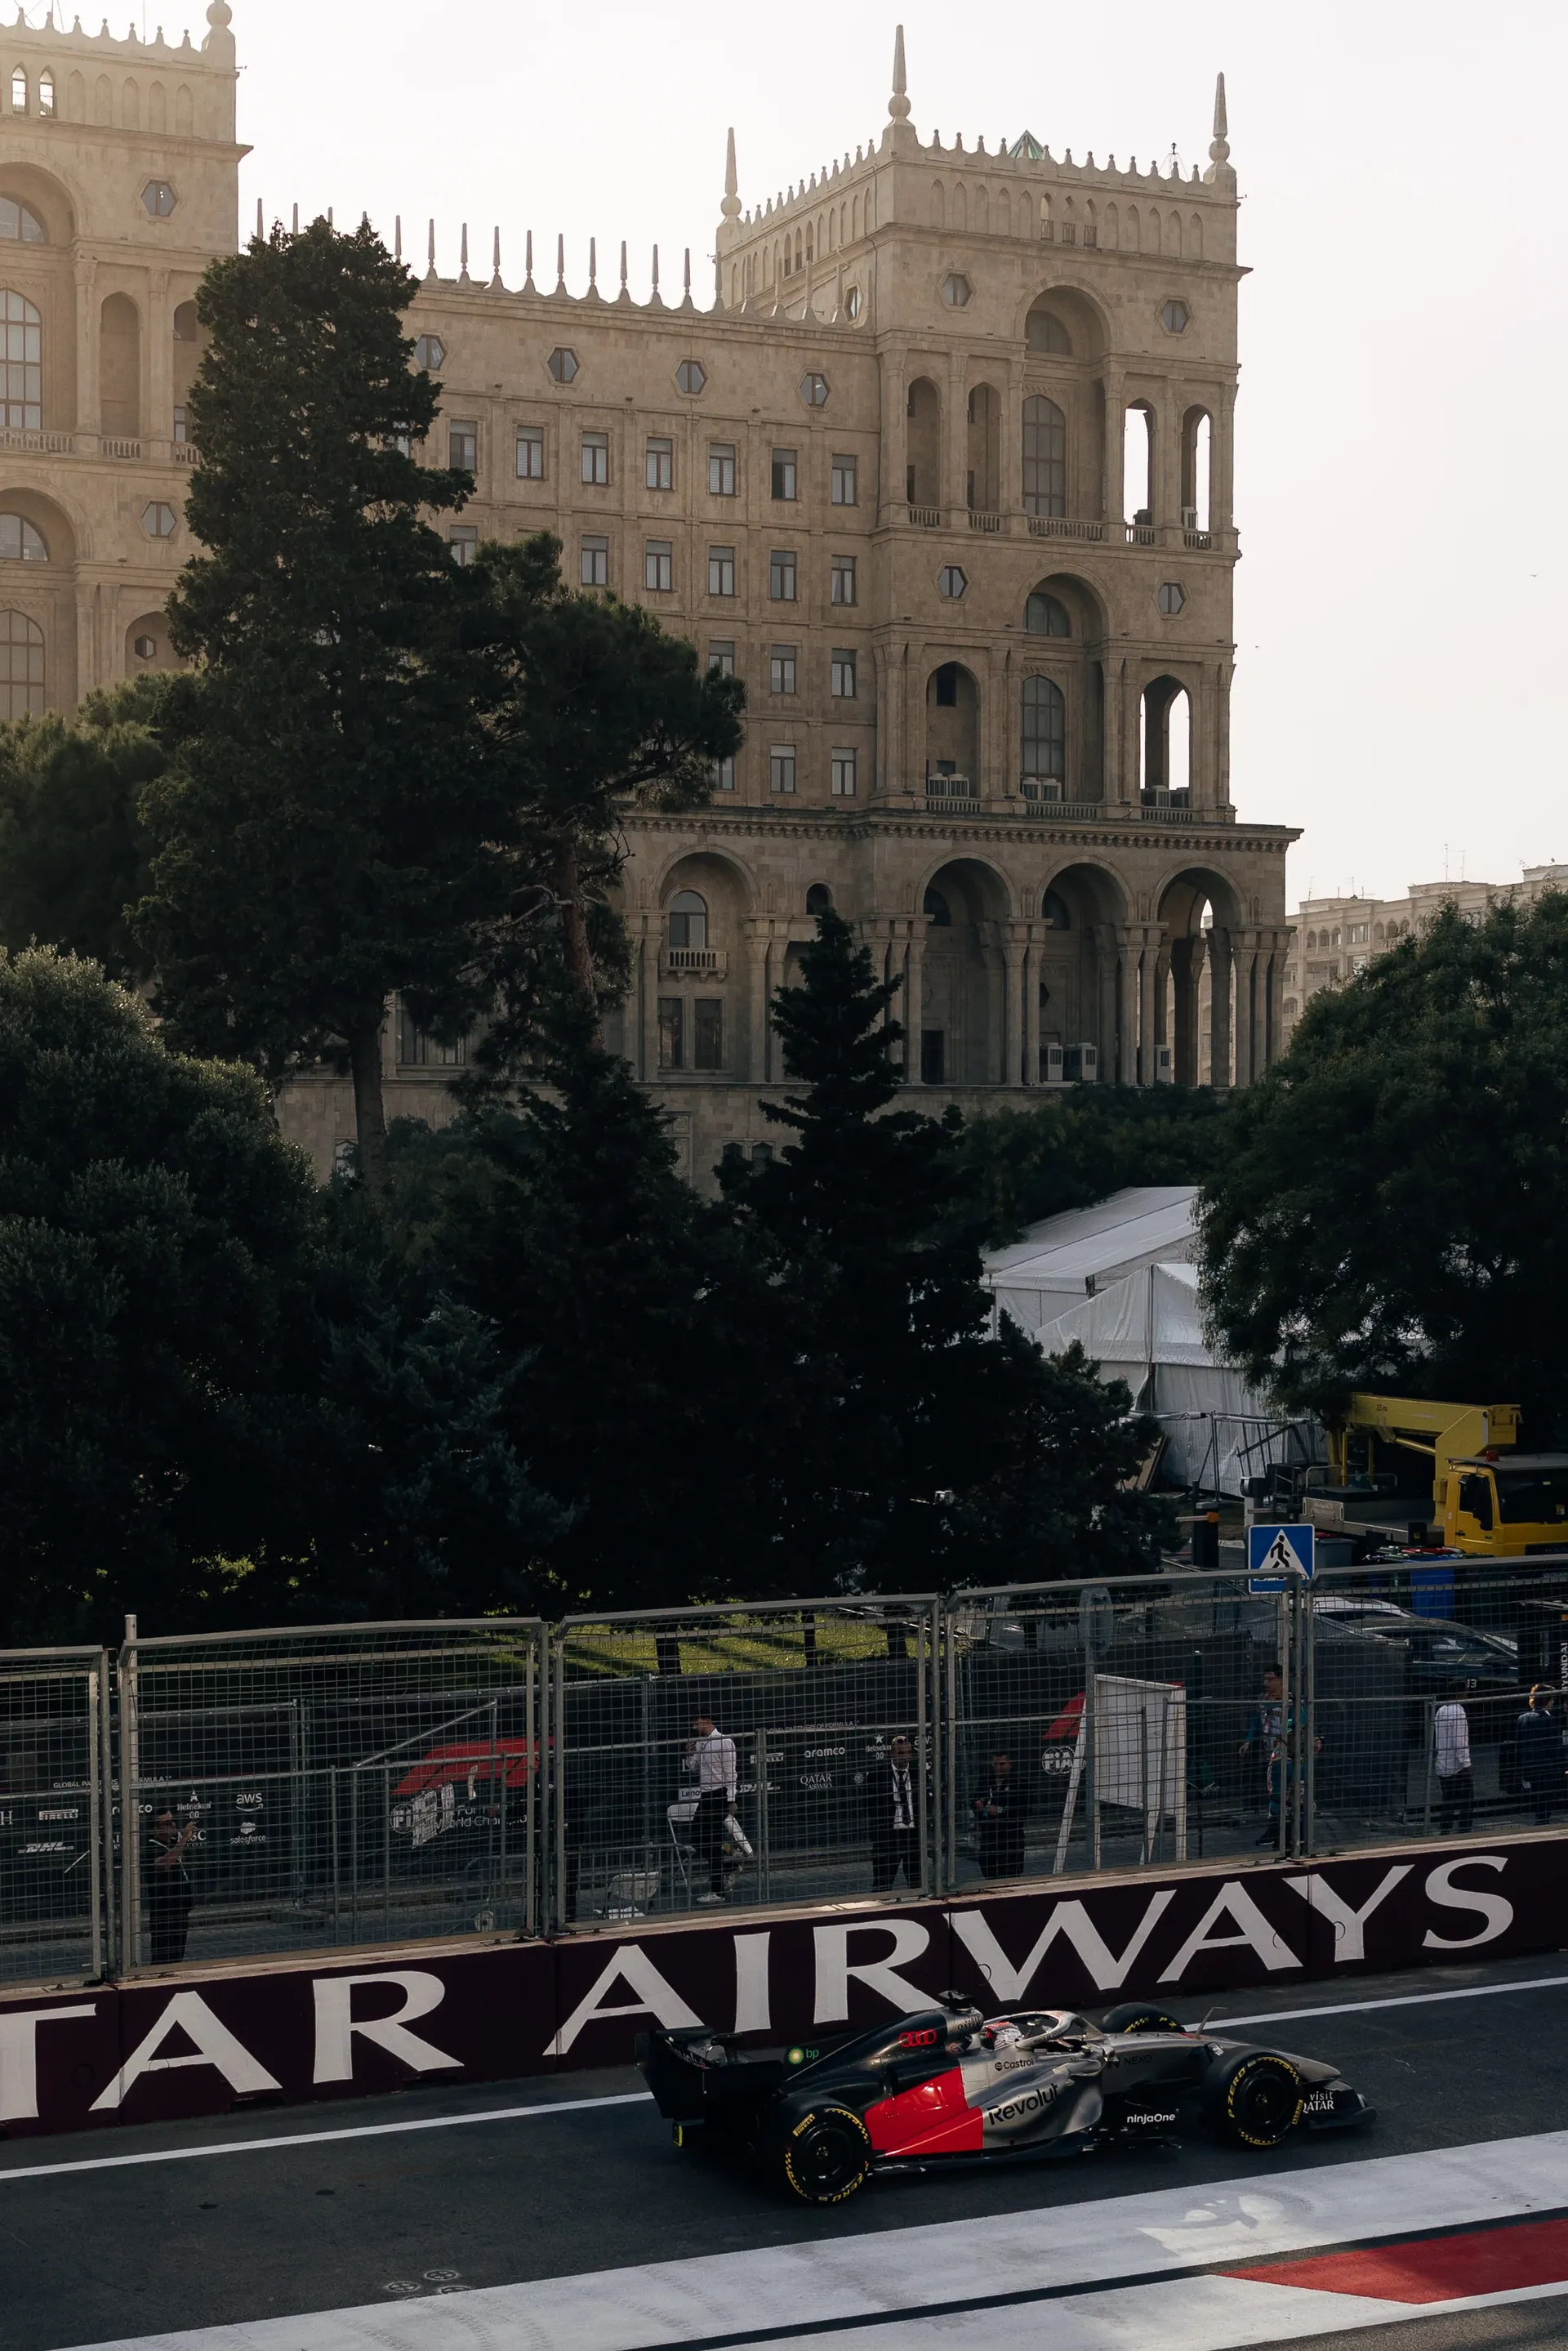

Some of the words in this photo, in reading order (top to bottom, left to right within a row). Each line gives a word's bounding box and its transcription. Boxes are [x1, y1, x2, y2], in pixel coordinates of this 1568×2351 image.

[804, 1747, 845, 1758] aramco
[866, 1744, 892, 1752] Heineke
[53, 1781, 81, 1789] GLOBAL
[800, 1773, 832, 1786] QATAR
[236, 1792, 263, 1805] aws
[176, 1802, 211, 1811] Heineken
[38, 1809, 78, 1821] PIRELLI
[230, 1834, 266, 1845] salesforce
[26, 1841, 67, 1853] DHL
[542, 1856, 1514, 2056] AIRWAYS
[806, 2049, 819, 2059] bp
[1124, 2054, 1153, 2066] NEXO
[1004, 2058, 1035, 2070] Castrol
[1227, 2066, 1246, 2106] ZERO
[1309, 2090, 1334, 2101] visit
[987, 2082, 1059, 2125] Revolut
[1126, 2112, 1176, 2124] ninjaOne
